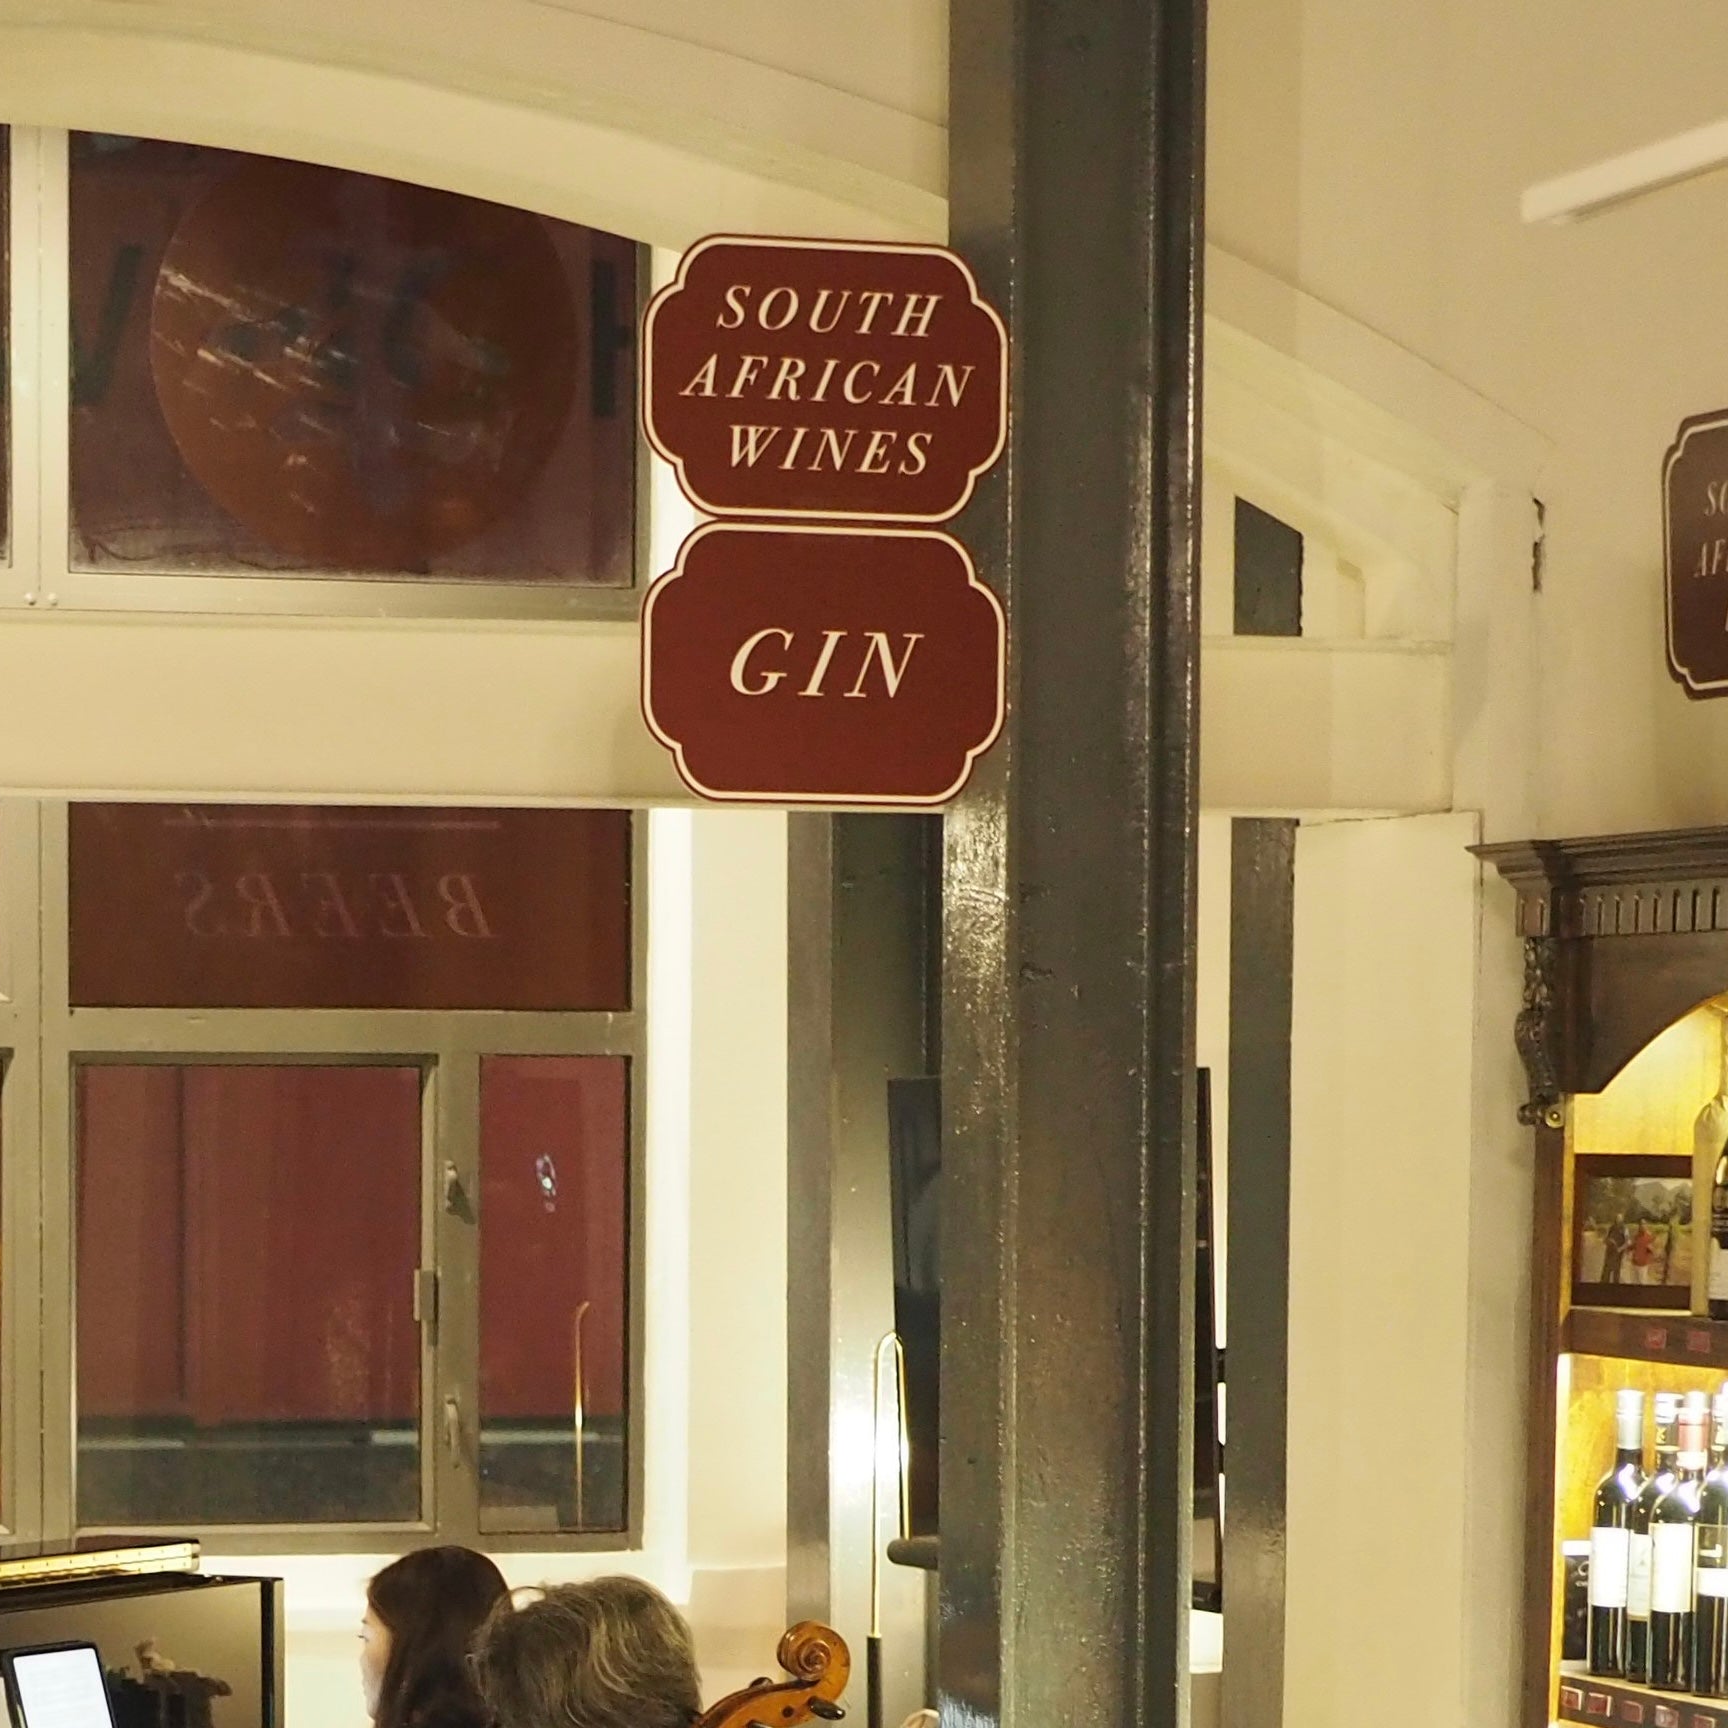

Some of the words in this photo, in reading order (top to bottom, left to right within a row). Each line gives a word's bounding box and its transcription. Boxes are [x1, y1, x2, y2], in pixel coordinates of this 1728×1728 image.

[716, 285, 943, 338] SOUTH
[679, 353, 975, 408] AFRICAN
[728, 424, 933, 476] WINES
[729, 627, 925, 699] GIN
